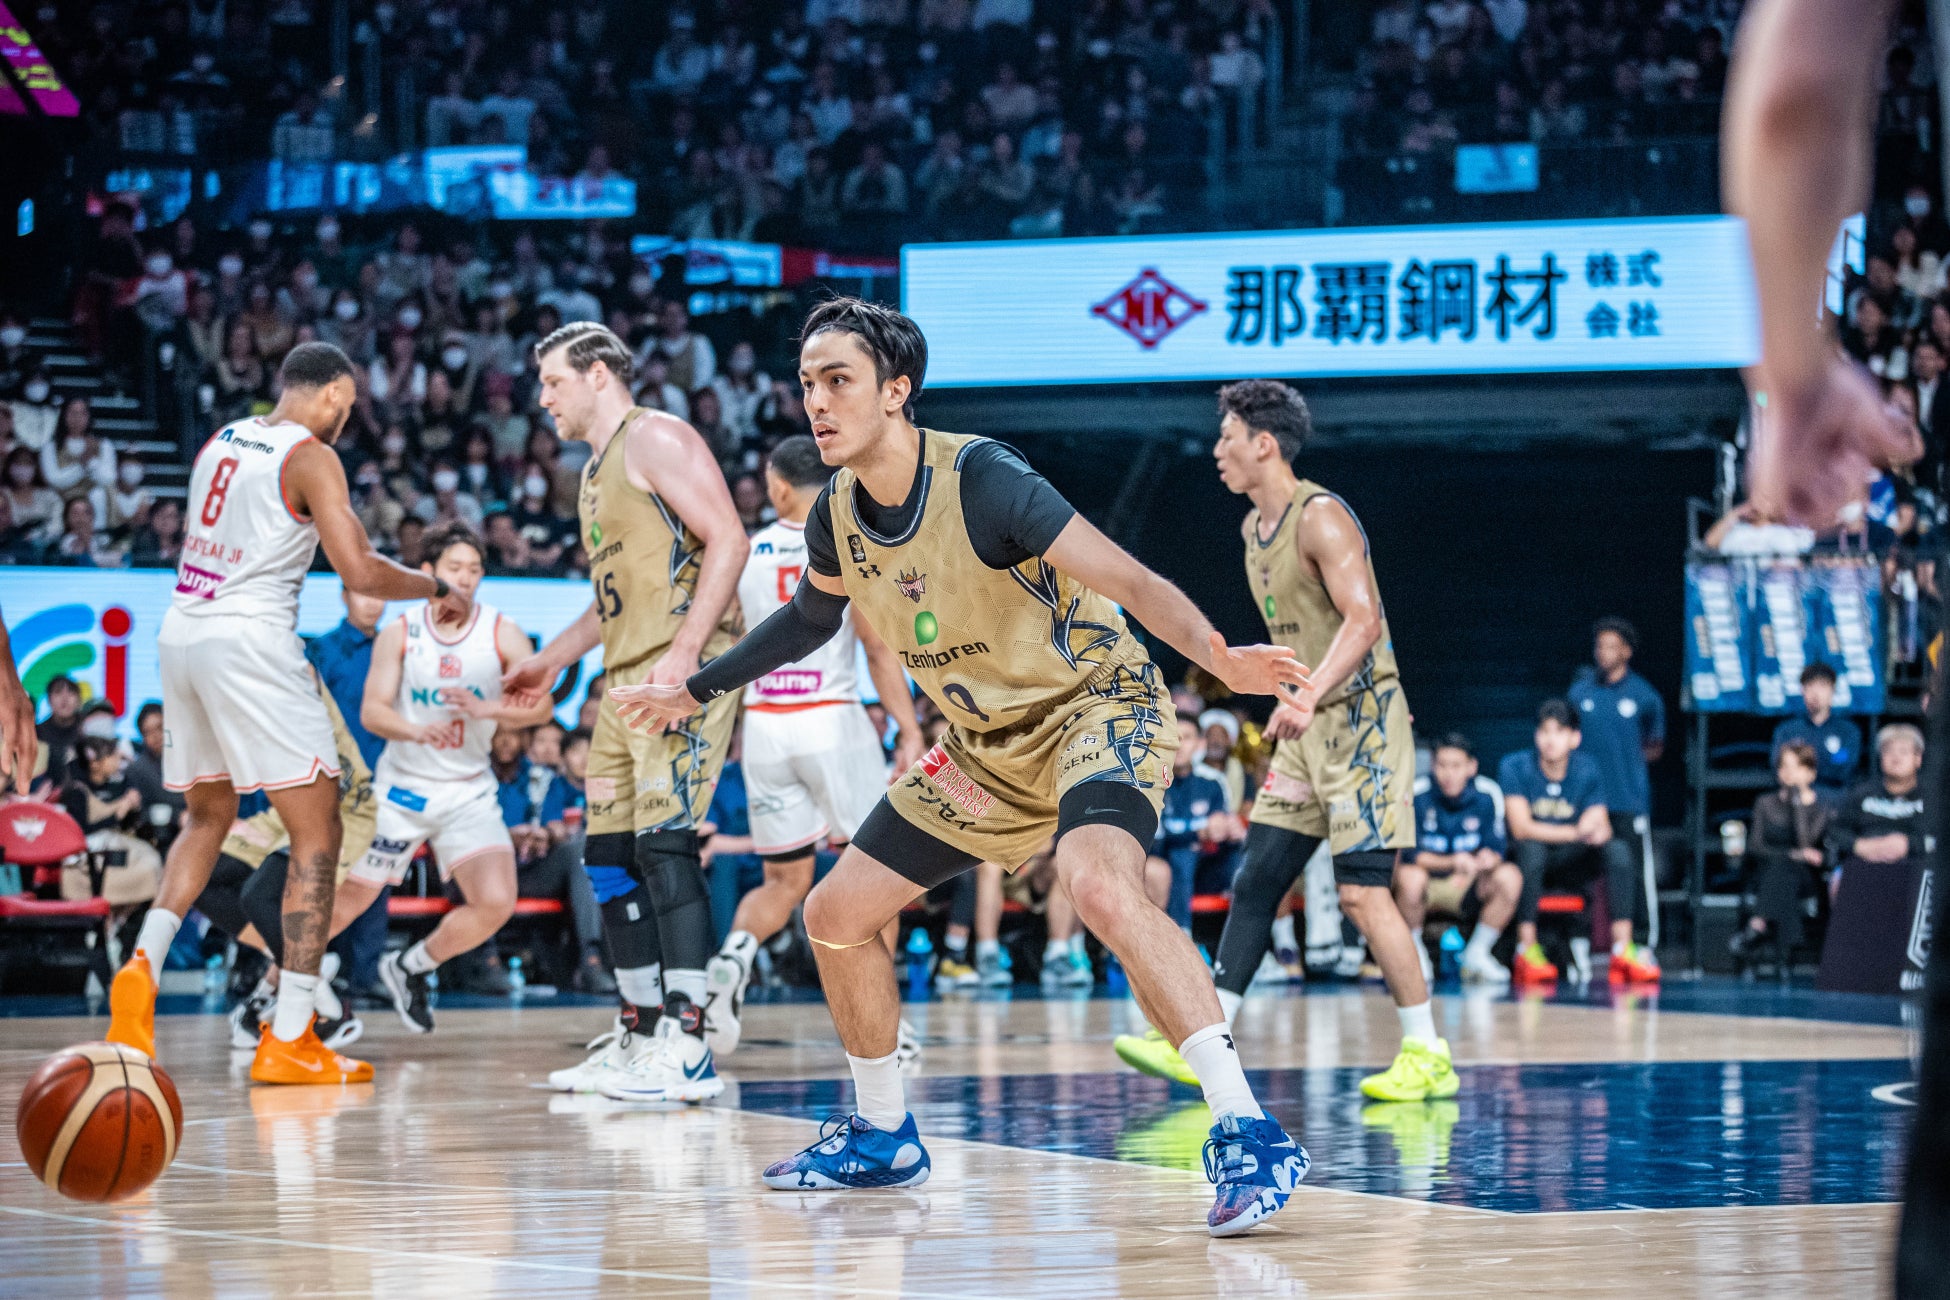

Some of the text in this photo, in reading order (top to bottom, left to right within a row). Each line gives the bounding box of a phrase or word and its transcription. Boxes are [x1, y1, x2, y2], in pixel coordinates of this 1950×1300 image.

[1586, 252, 1661, 288] 株式
[1224, 256, 1568, 343] 那覇鋼材
[1586, 302, 1661, 338] 会社
[231, 436, 275, 455] marimo
[200, 456, 240, 528] 8
[898, 641, 991, 669] Zenhoren
[904, 775, 977, 831] ナンセイ
[932, 773, 988, 819] DAIHATSU
[943, 761, 997, 809] RYUKYU
